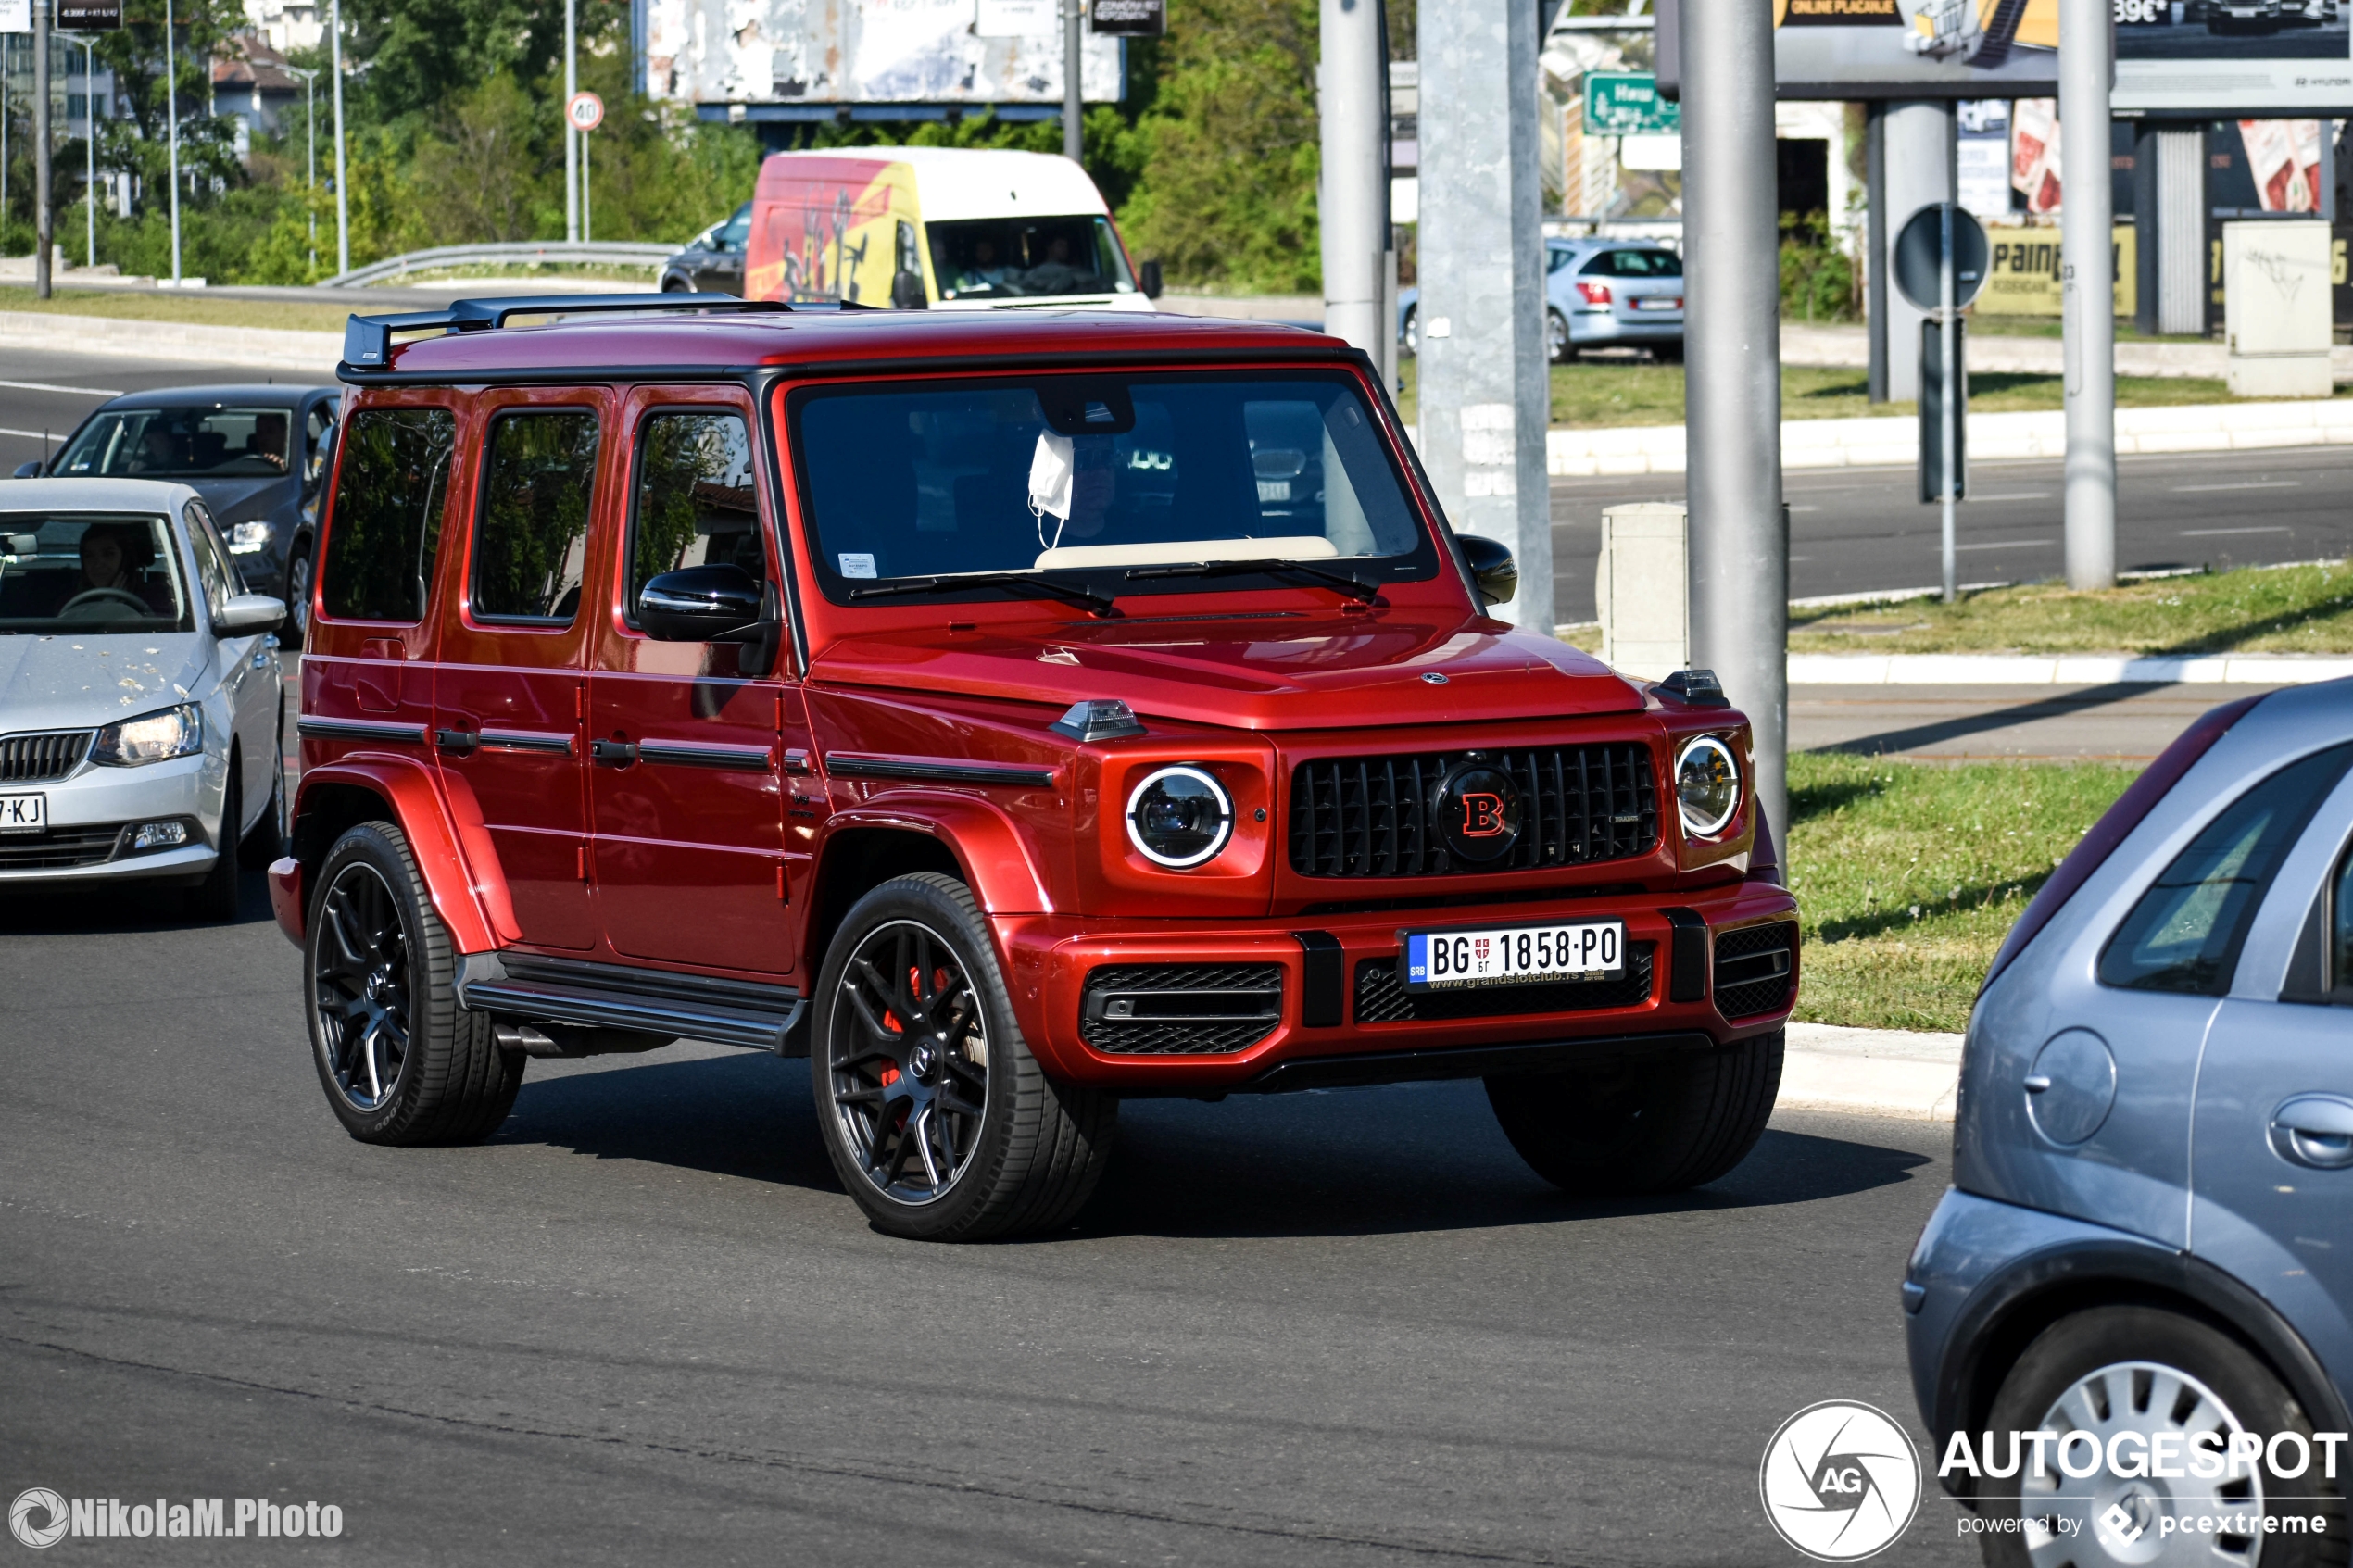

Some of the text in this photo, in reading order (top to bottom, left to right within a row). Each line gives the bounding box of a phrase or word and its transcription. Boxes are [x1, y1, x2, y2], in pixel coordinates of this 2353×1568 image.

[1791, 0, 1835, 14] ONLINE
[575, 103, 596, 120] 40
[1462, 792, 1505, 837] B
[1433, 936, 1469, 975] BG
[1410, 966, 1426, 976] SRB
